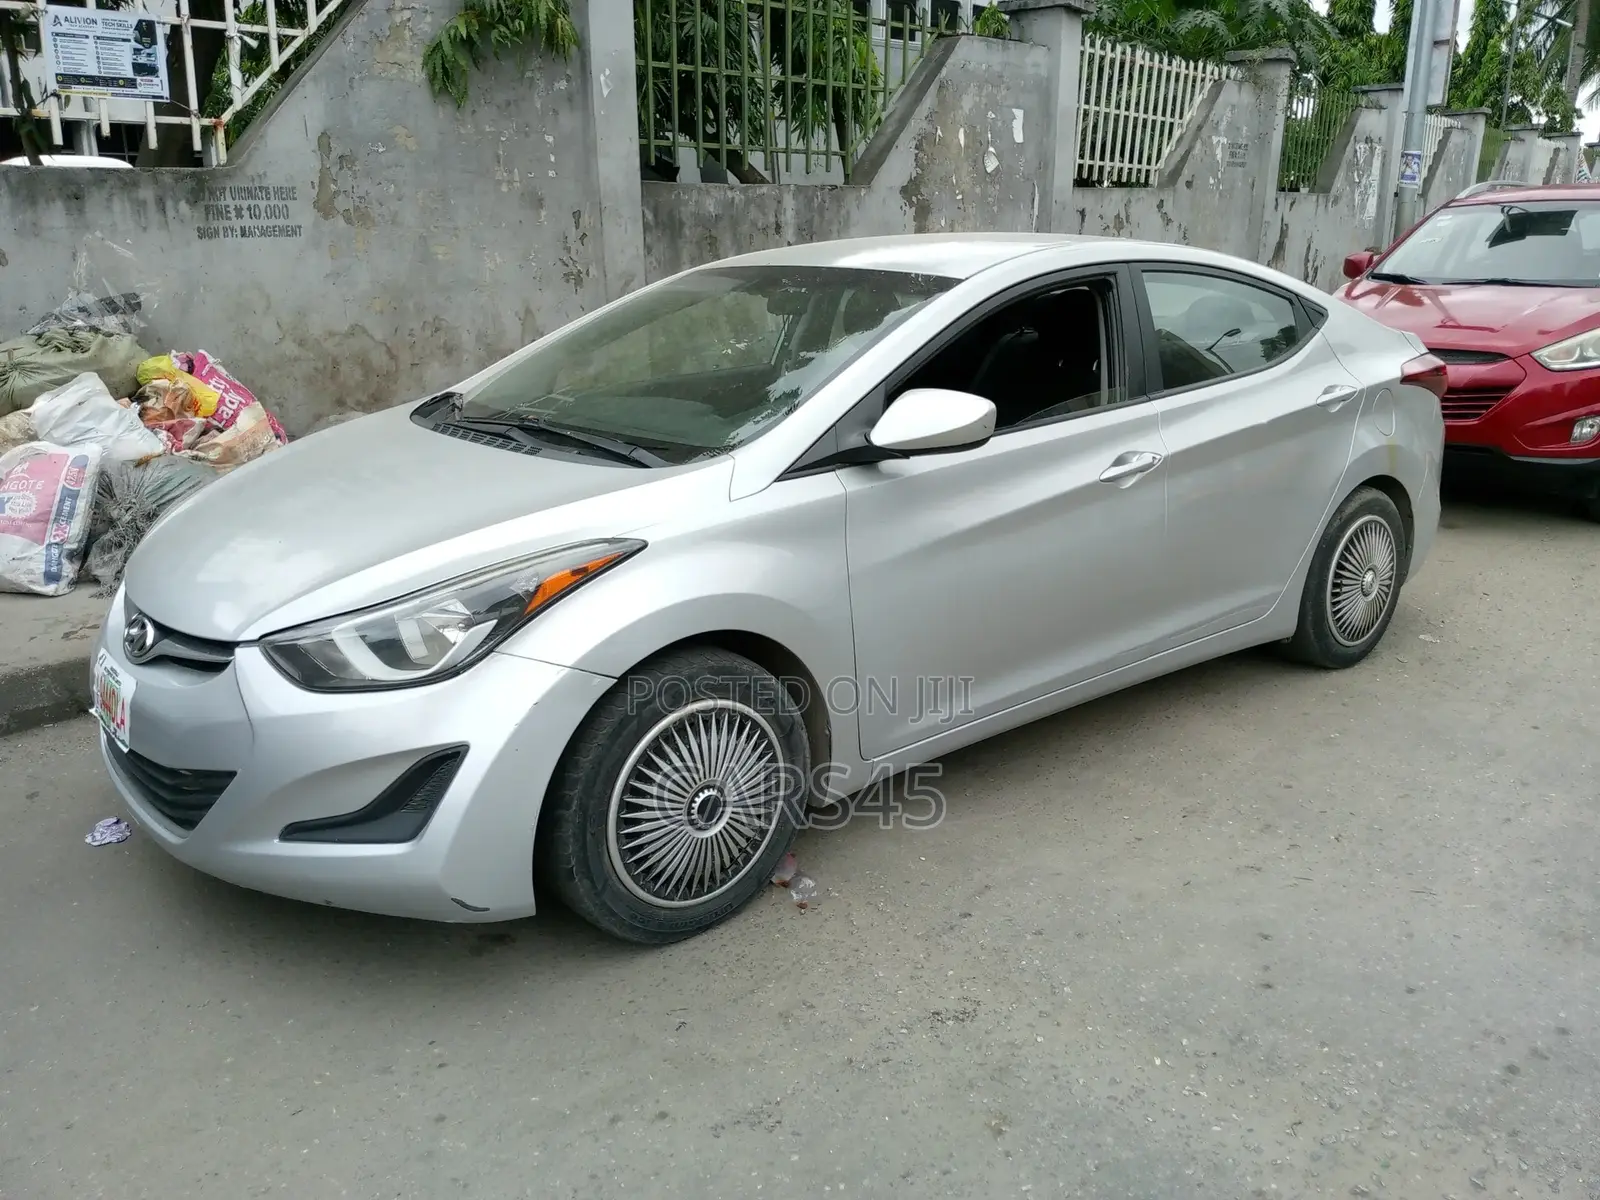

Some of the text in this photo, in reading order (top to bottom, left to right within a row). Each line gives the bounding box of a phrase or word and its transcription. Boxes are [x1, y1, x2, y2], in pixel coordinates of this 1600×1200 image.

[64, 16, 98, 26] ALIVION
[273, 186, 298, 201] HERE
[204, 204, 233, 221] FINE
[197, 226, 220, 240] SIGN
[222, 226, 238, 239] BY:
[207, 389, 247, 428] Lady
[0, 480, 44, 492] NGOTE
[60, 496, 74, 526] CEMENT
